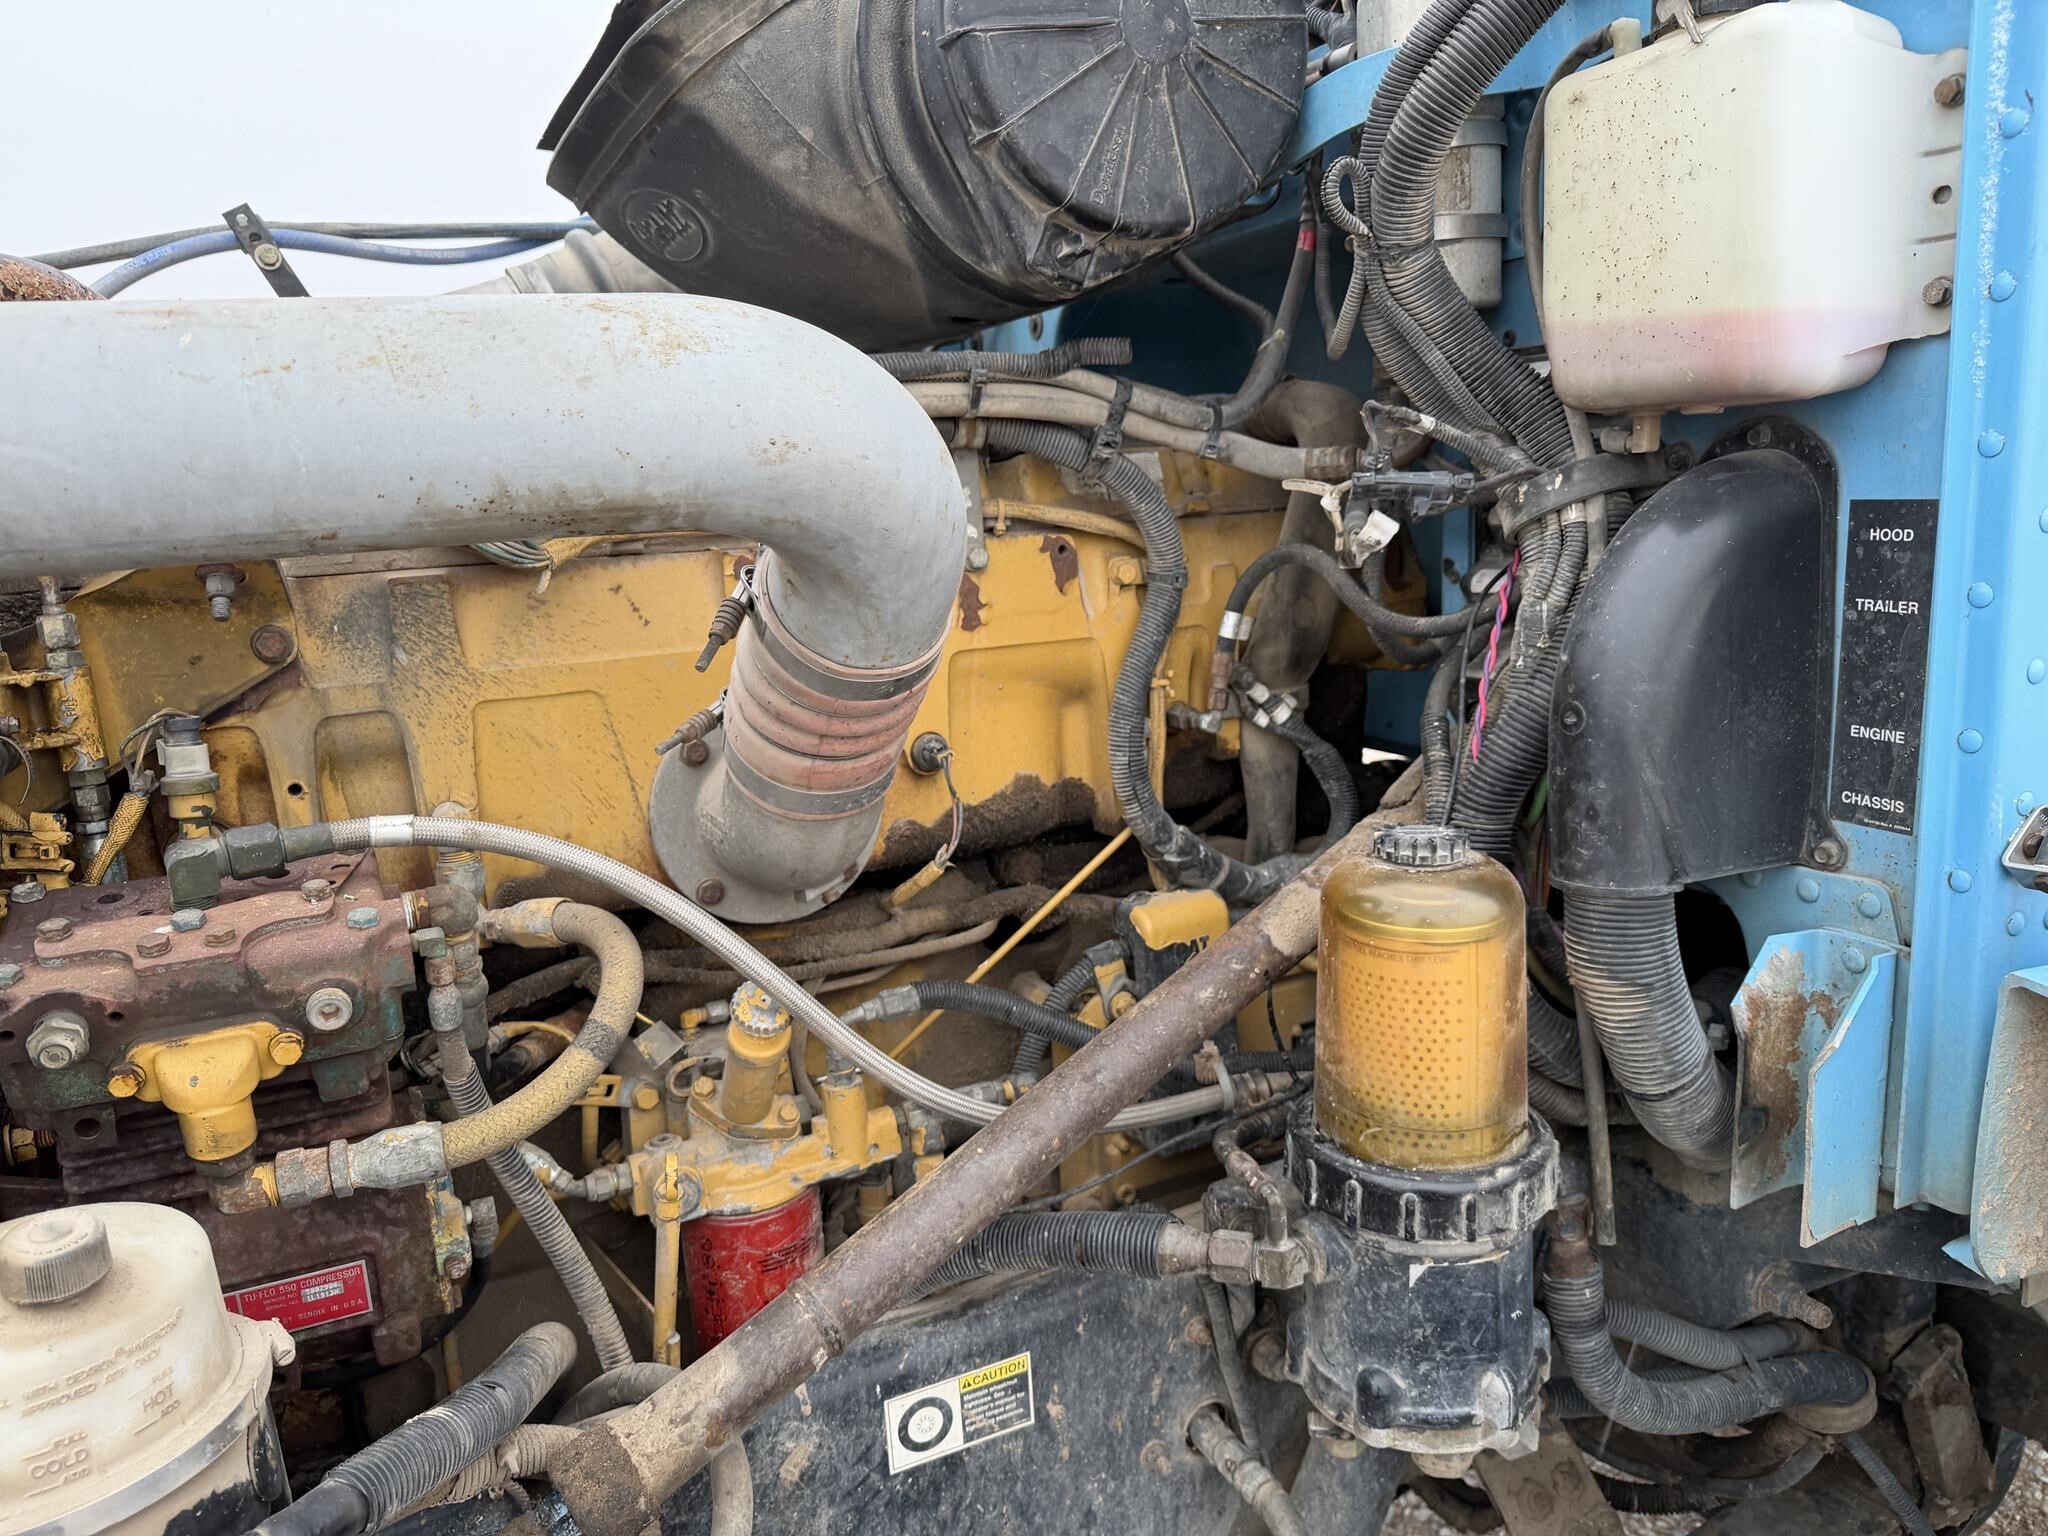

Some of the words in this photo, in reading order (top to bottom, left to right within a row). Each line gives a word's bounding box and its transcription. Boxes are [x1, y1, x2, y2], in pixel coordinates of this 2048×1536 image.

[1089, 126, 1126, 206] Donaldson
[1869, 528, 1914, 542] HOOD
[1855, 598, 1919, 615] TRAILER
[1850, 724, 1905, 744] ENGINE
[1841, 791, 1905, 813] CHASSIS
[243, 1289, 275, 1303] TU-FLO
[279, 1283, 297, 1295] 550
[300, 1267, 361, 1289] COMPRESSOR
[331, 1304, 339, 1312] IN
[973, 1360, 1025, 1385] CAUTION
[20, 1382, 97, 1418] APPROVED
[142, 1381, 175, 1413] HOT
[963, 1388, 988, 1401] Maintain
[1016, 1391, 1025, 1399] for
[53, 1430, 88, 1449] FULL
[29, 1447, 90, 1480] COLD
[61, 1465, 90, 1486] ADD
